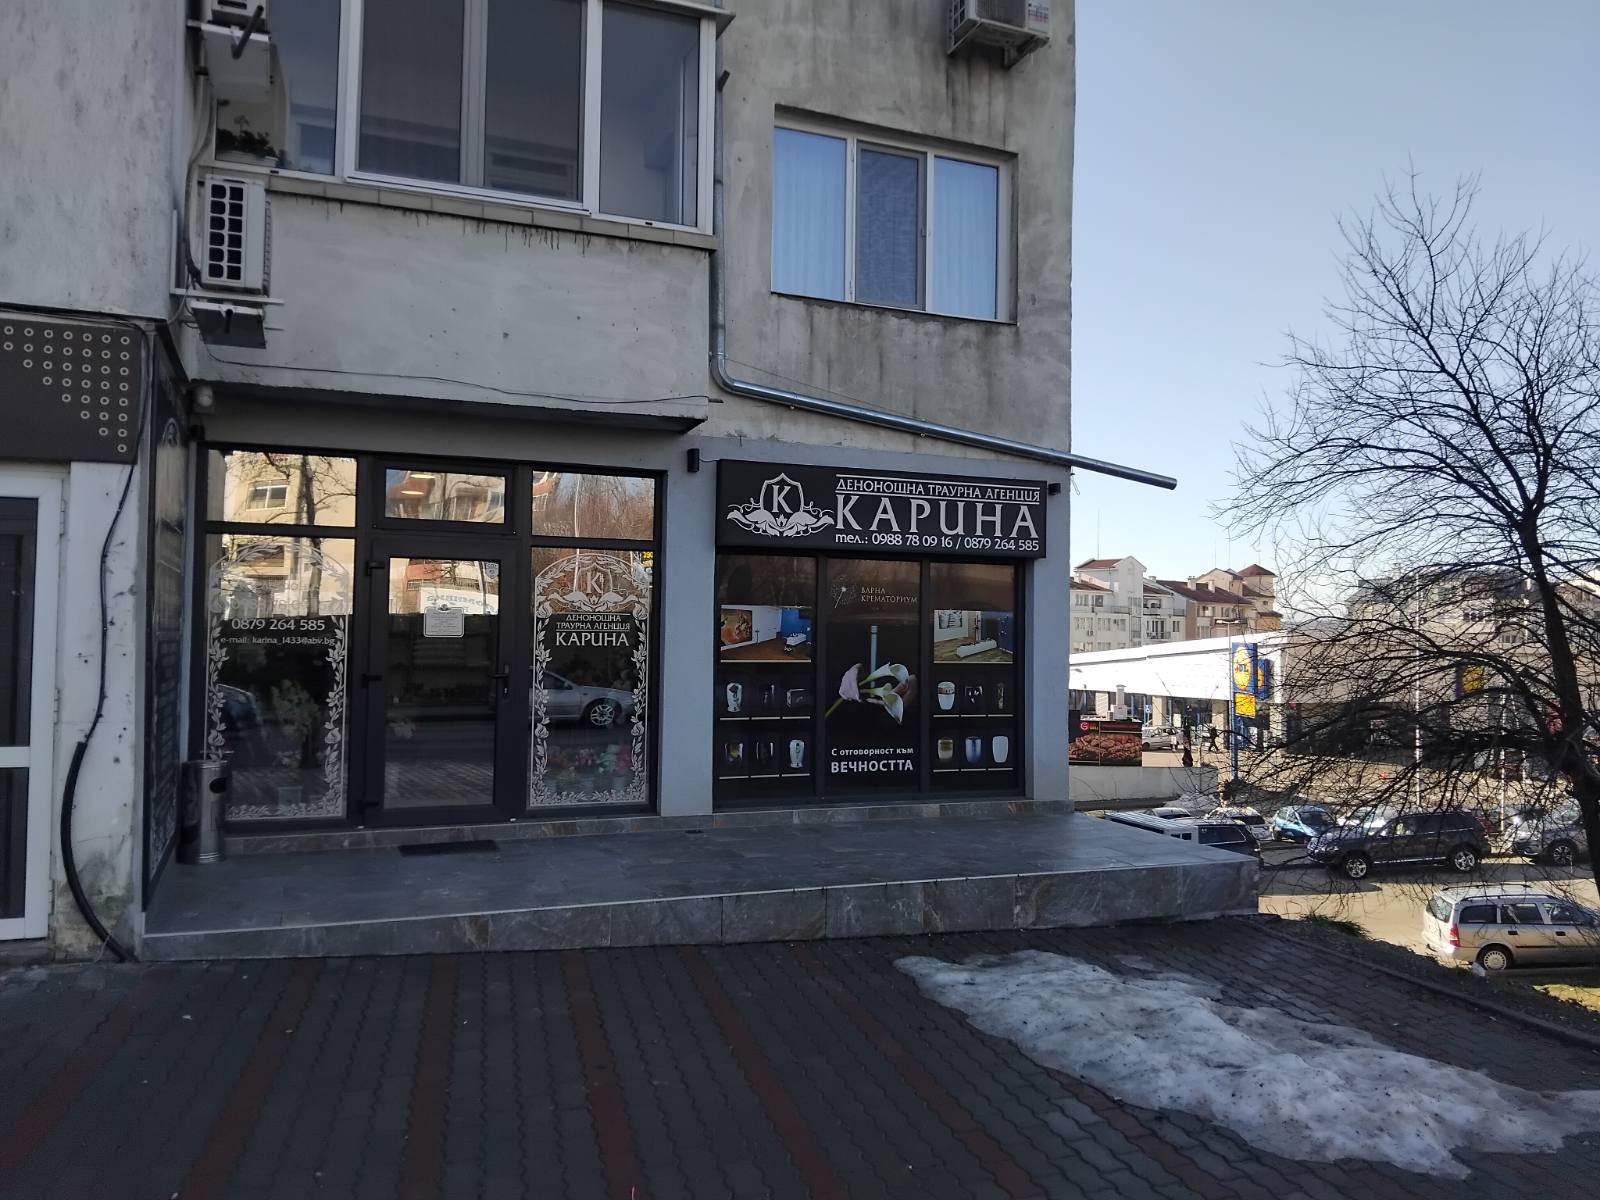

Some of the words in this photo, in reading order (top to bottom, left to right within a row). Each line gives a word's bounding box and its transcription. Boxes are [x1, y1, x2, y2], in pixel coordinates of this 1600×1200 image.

[836, 479, 925, 495] ДЕНОНОЩНА
[928, 485, 982, 498] ТРАУРНА
[985, 488, 1040, 502] АГЕНЦИЯ
[835, 494, 1039, 539] КАРИНА
[871, 533, 903, 546] 0988
[905, 534, 920, 546] 78
[922, 535, 938, 547] 09
[941, 536, 953, 548] 16
[956, 537, 962, 550] /
[964, 537, 991, 550] 0879
[994, 538, 1016, 550] 264
[1018, 539, 1039, 551] 585
[231, 618, 266, 630] 0879
[269, 619, 296, 631] 264
[300, 619, 326, 631] 585
[557, 622, 592, 630] ТРАУРНА
[593, 622, 630, 630] АГЕНЦИЯ
[220, 636, 249, 644] e-mail:
[555, 632, 630, 647] КАРИНА
[831, 748, 837, 756] С
[839, 748, 894, 757] отговорност
[831, 759, 914, 773] ВЕЧНОСТТА
